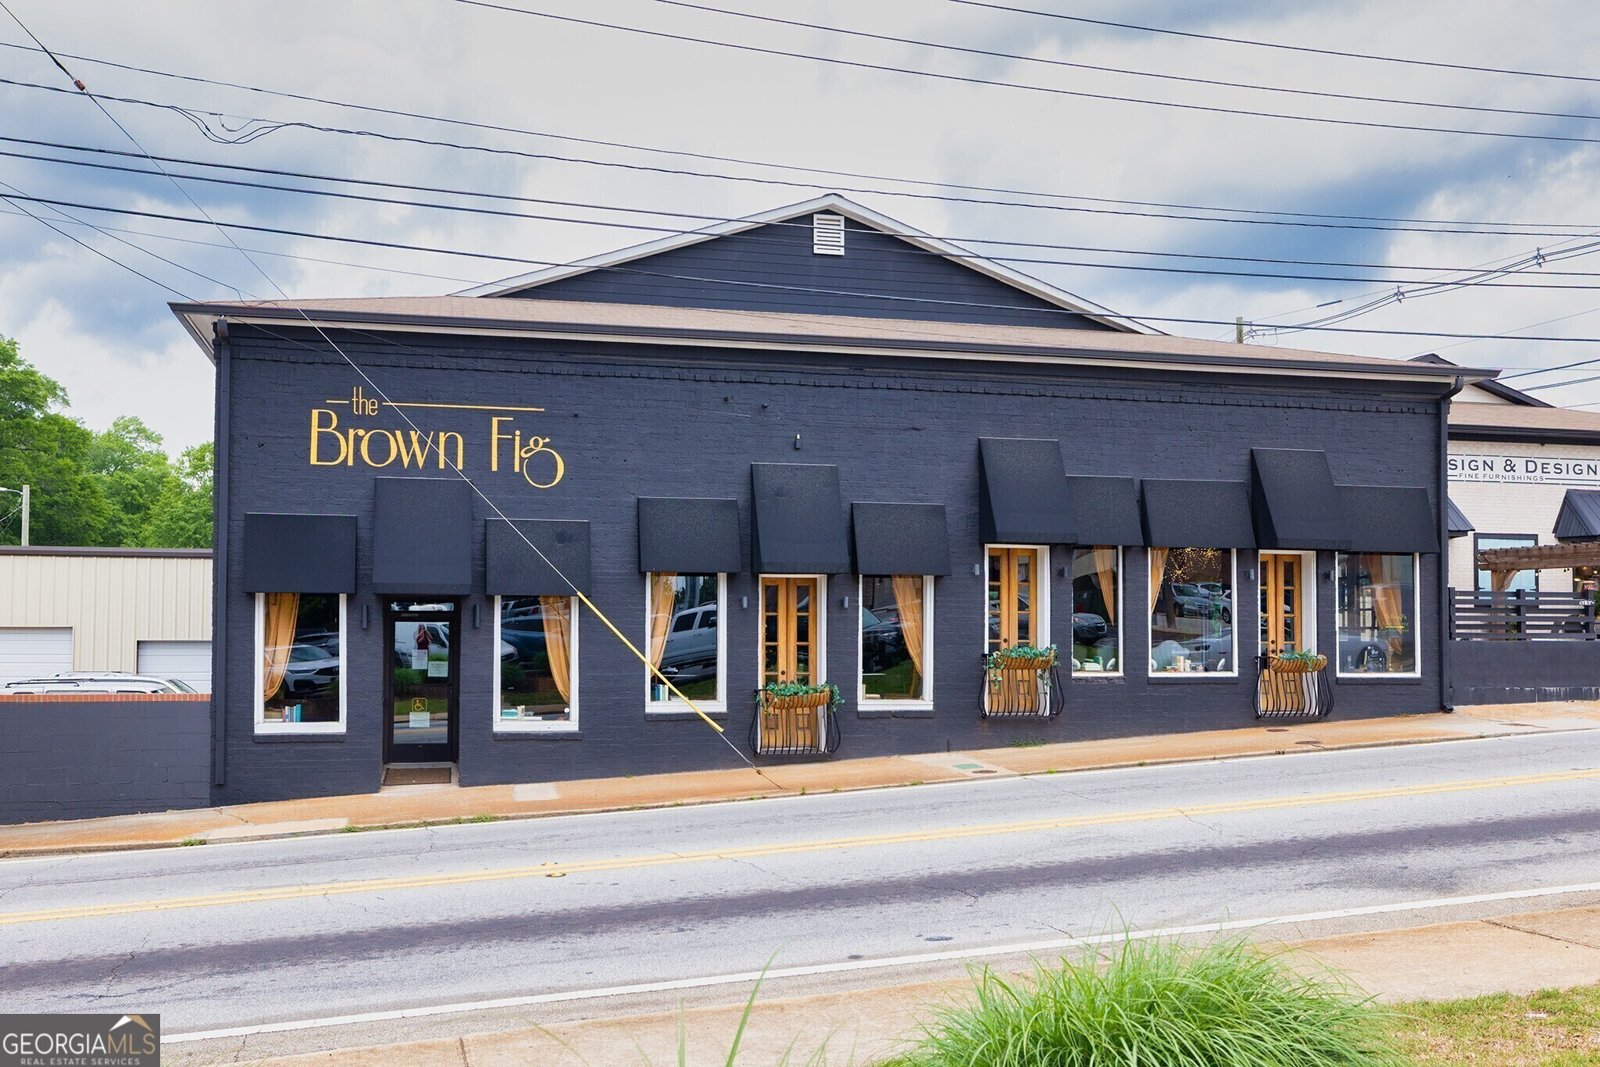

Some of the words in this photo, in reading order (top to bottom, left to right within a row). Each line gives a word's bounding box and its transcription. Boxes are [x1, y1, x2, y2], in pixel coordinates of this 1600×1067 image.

[352, 386, 378, 416] the
[309, 408, 464, 470] Brown
[491, 416, 565, 489] Fig
[1503, 458, 1516, 473] &
[1483, 473, 1545, 482] FURNISHINGS
